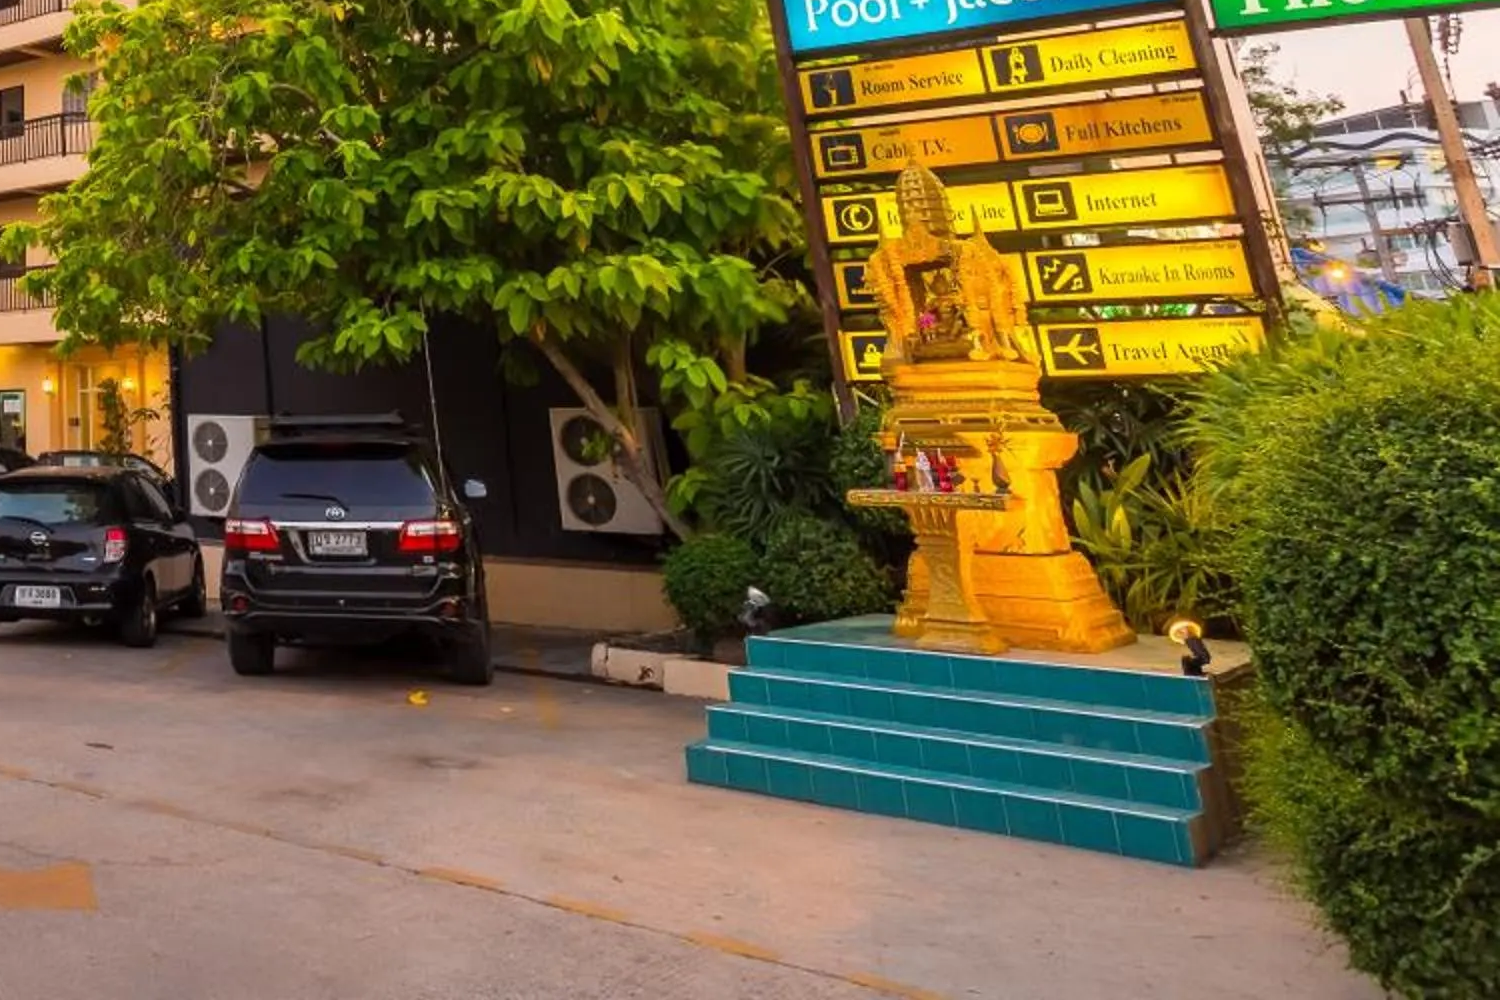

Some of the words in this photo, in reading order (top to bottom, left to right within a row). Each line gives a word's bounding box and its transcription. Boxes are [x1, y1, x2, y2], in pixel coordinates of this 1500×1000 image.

[1049, 51, 1093, 73] Daily
[1098, 43, 1178, 66] Cleaning
[860, 79, 905, 96] Room
[908, 71, 964, 90] Service
[1064, 122, 1099, 142] Full
[1104, 116, 1183, 139] Kitchens
[918, 137, 953, 157] T.V.
[1086, 191, 1159, 212] Internet
[1098, 265, 1161, 286] Karaoke
[1164, 264, 1182, 283] In
[1182, 260, 1236, 282] Rooms
[1108, 341, 1168, 361] Travel
